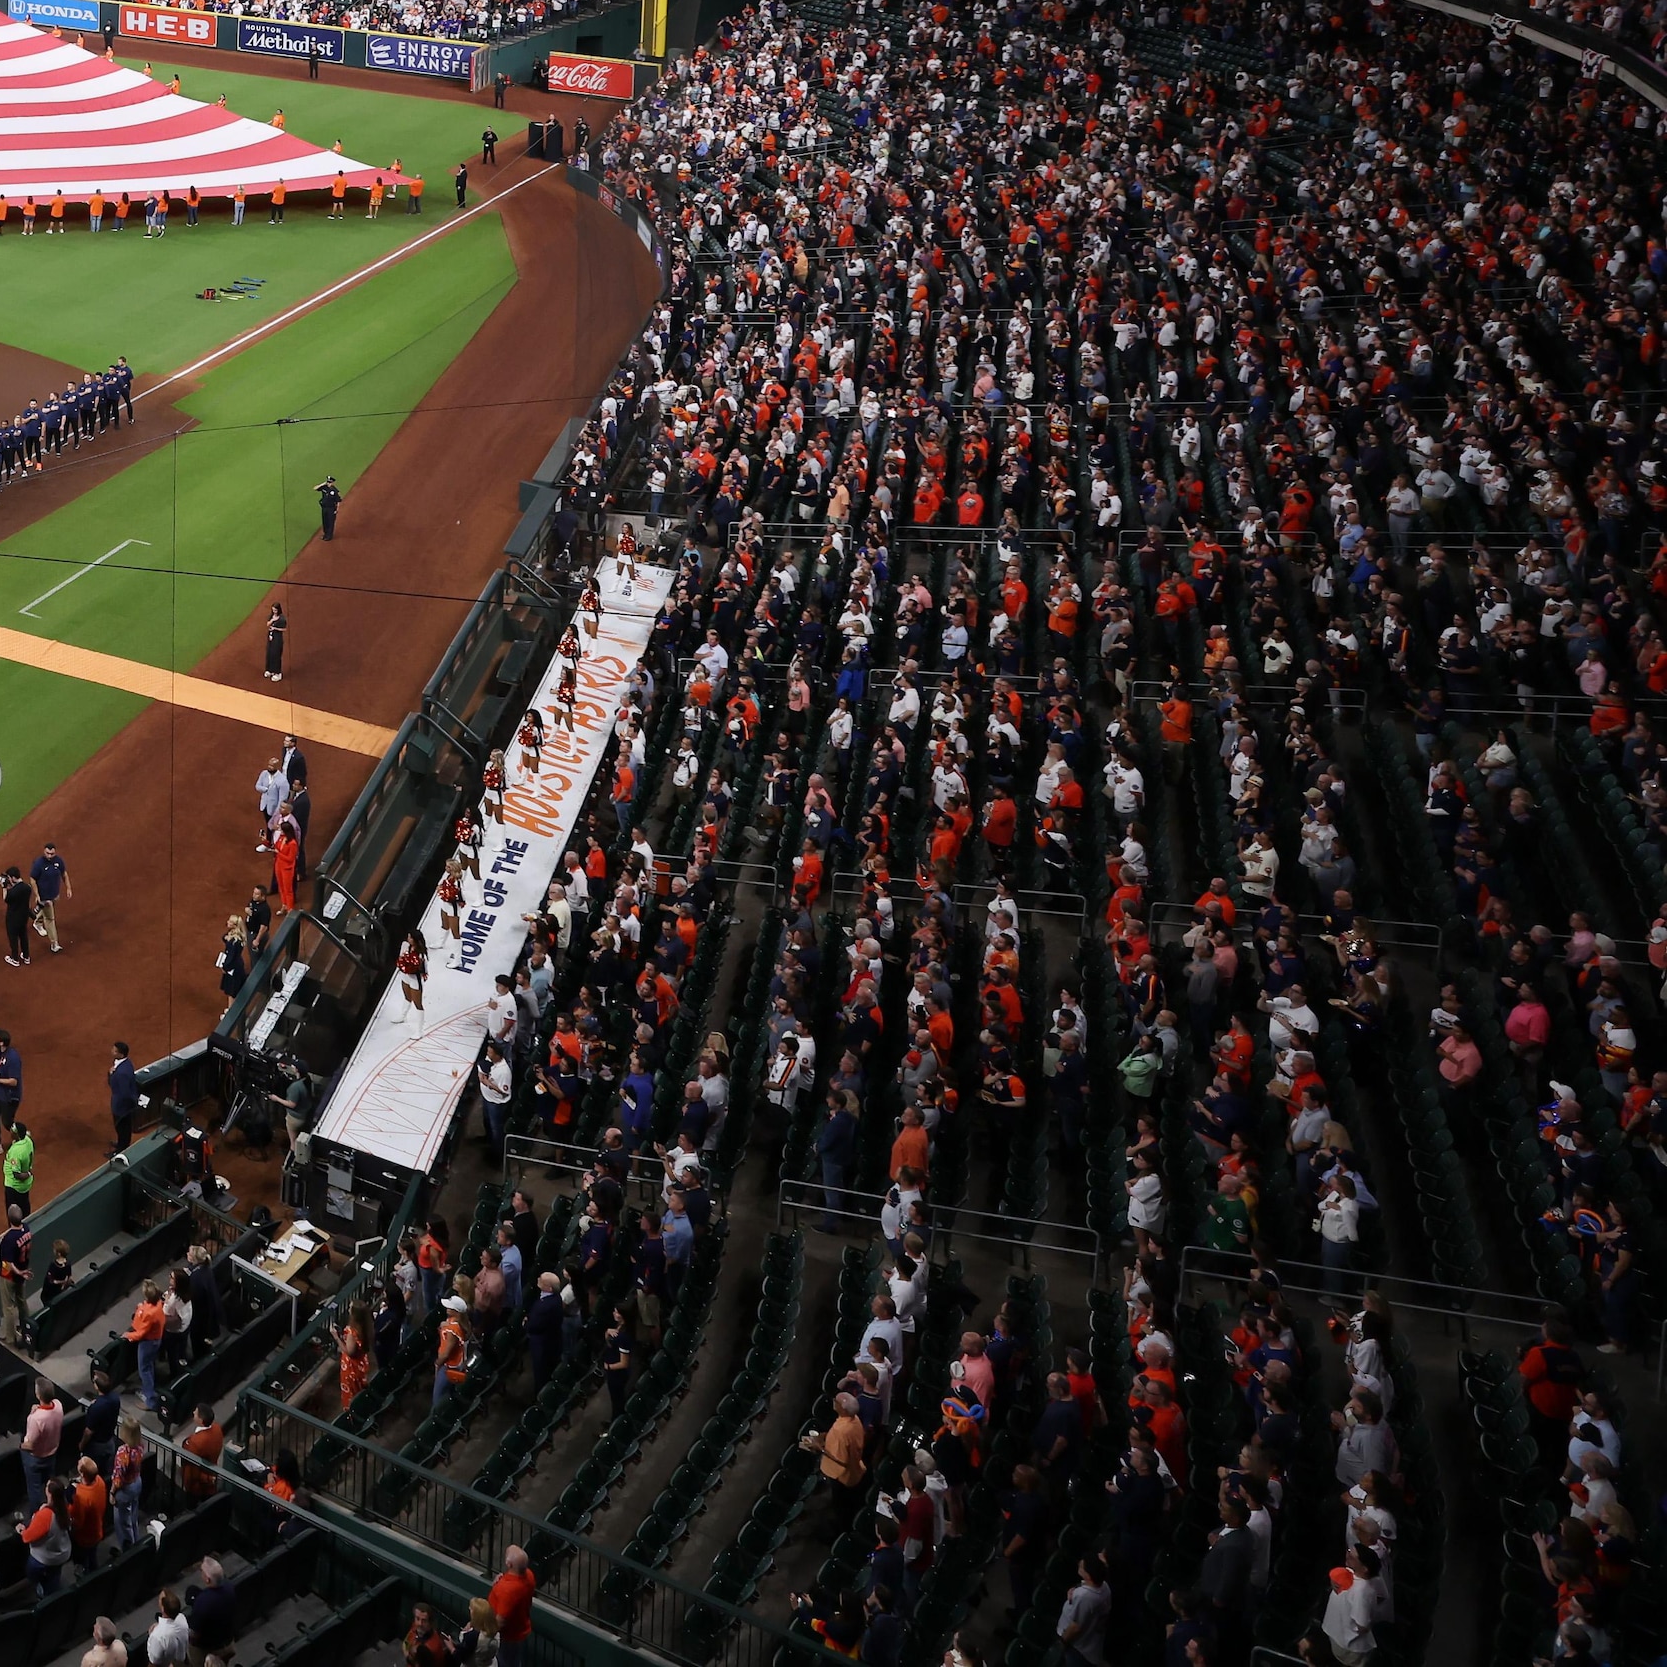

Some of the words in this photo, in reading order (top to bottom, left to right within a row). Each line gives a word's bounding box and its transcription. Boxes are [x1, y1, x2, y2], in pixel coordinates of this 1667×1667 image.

[26, 2, 97, 21] HONDA
[245, 23, 281, 34] HOUSTON
[245, 32, 334, 57] Methodist
[398, 41, 464, 60] ENERGY
[490, 838, 529, 877] THE
[484, 879, 509, 908] OF
[458, 909, 497, 974] HOME
